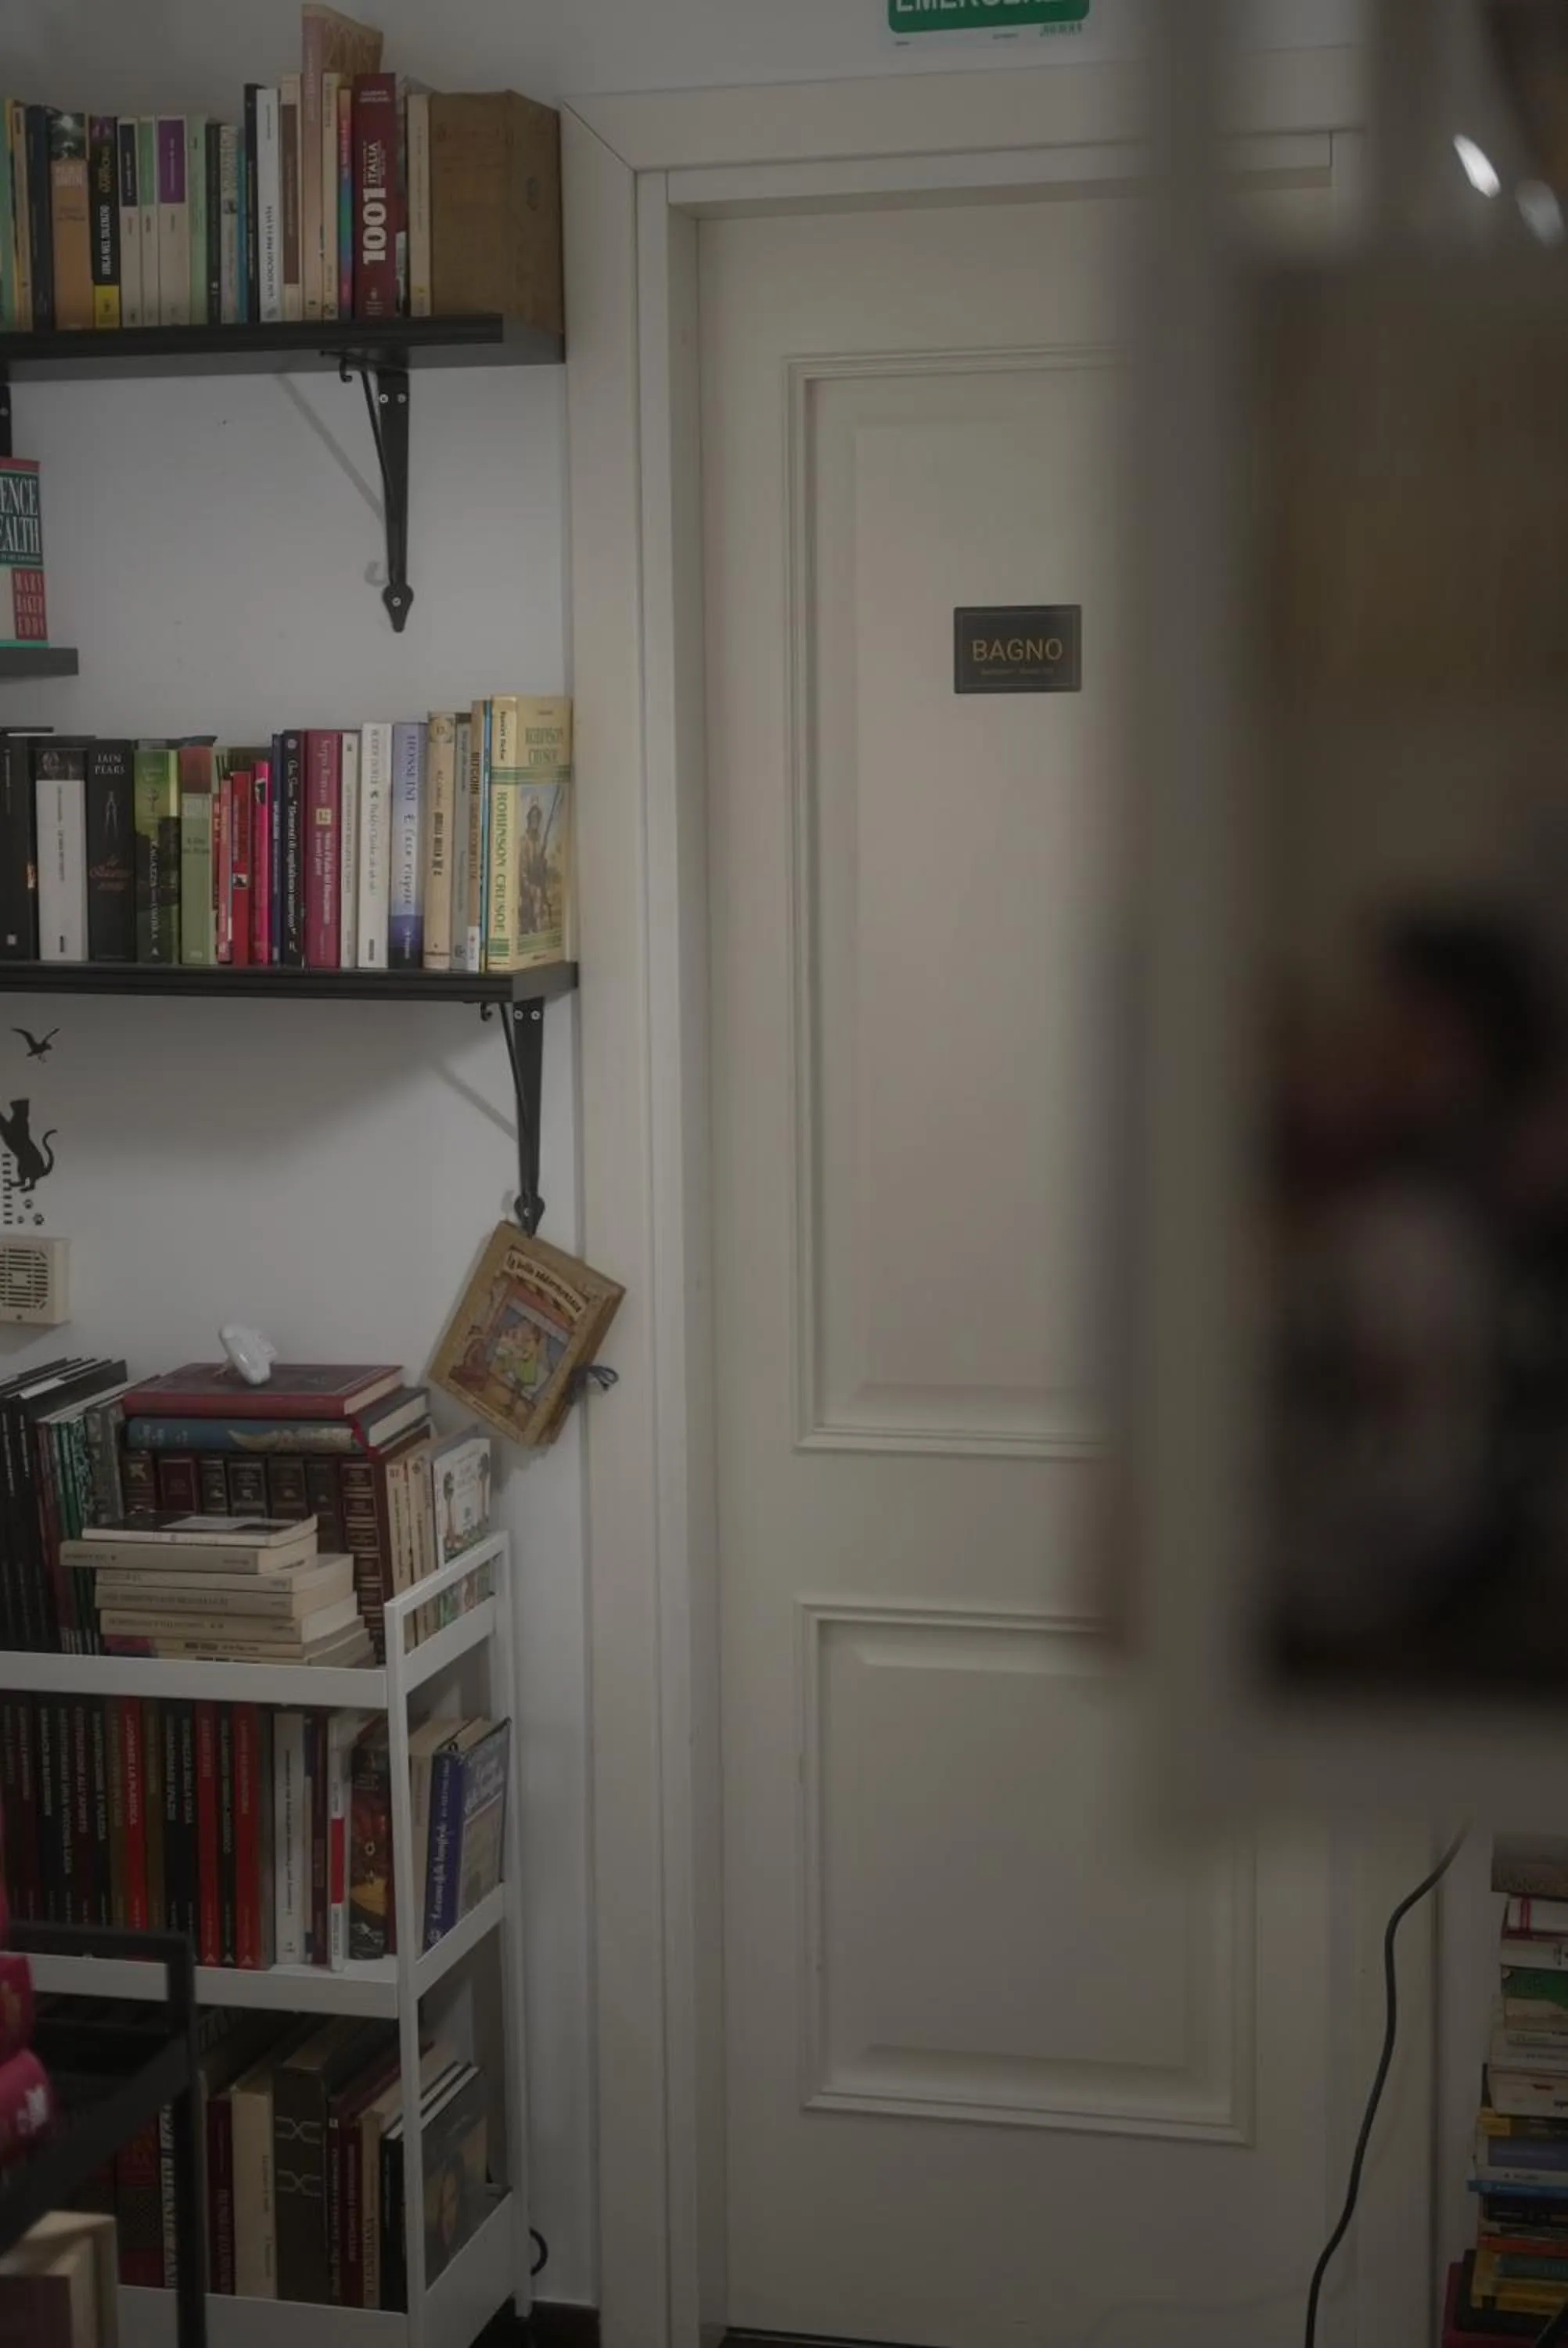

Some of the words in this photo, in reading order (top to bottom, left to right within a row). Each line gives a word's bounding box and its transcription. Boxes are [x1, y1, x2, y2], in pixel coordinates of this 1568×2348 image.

[368, 142, 379, 184] ITALIA
[362, 187, 387, 265] 1001
[972, 638, 1063, 661] BAGNO
[95, 765, 126, 776] PEARS
[98, 754, 124, 764] IAIN
[317, 739, 332, 766] Sergio
[405, 734, 416, 801] HOSSEINI
[470, 751, 480, 795] BITCOIN
[319, 768, 332, 804] Romano
[494, 791, 509, 867] ROBINSON
[494, 873, 509, 933] CRUSOE
